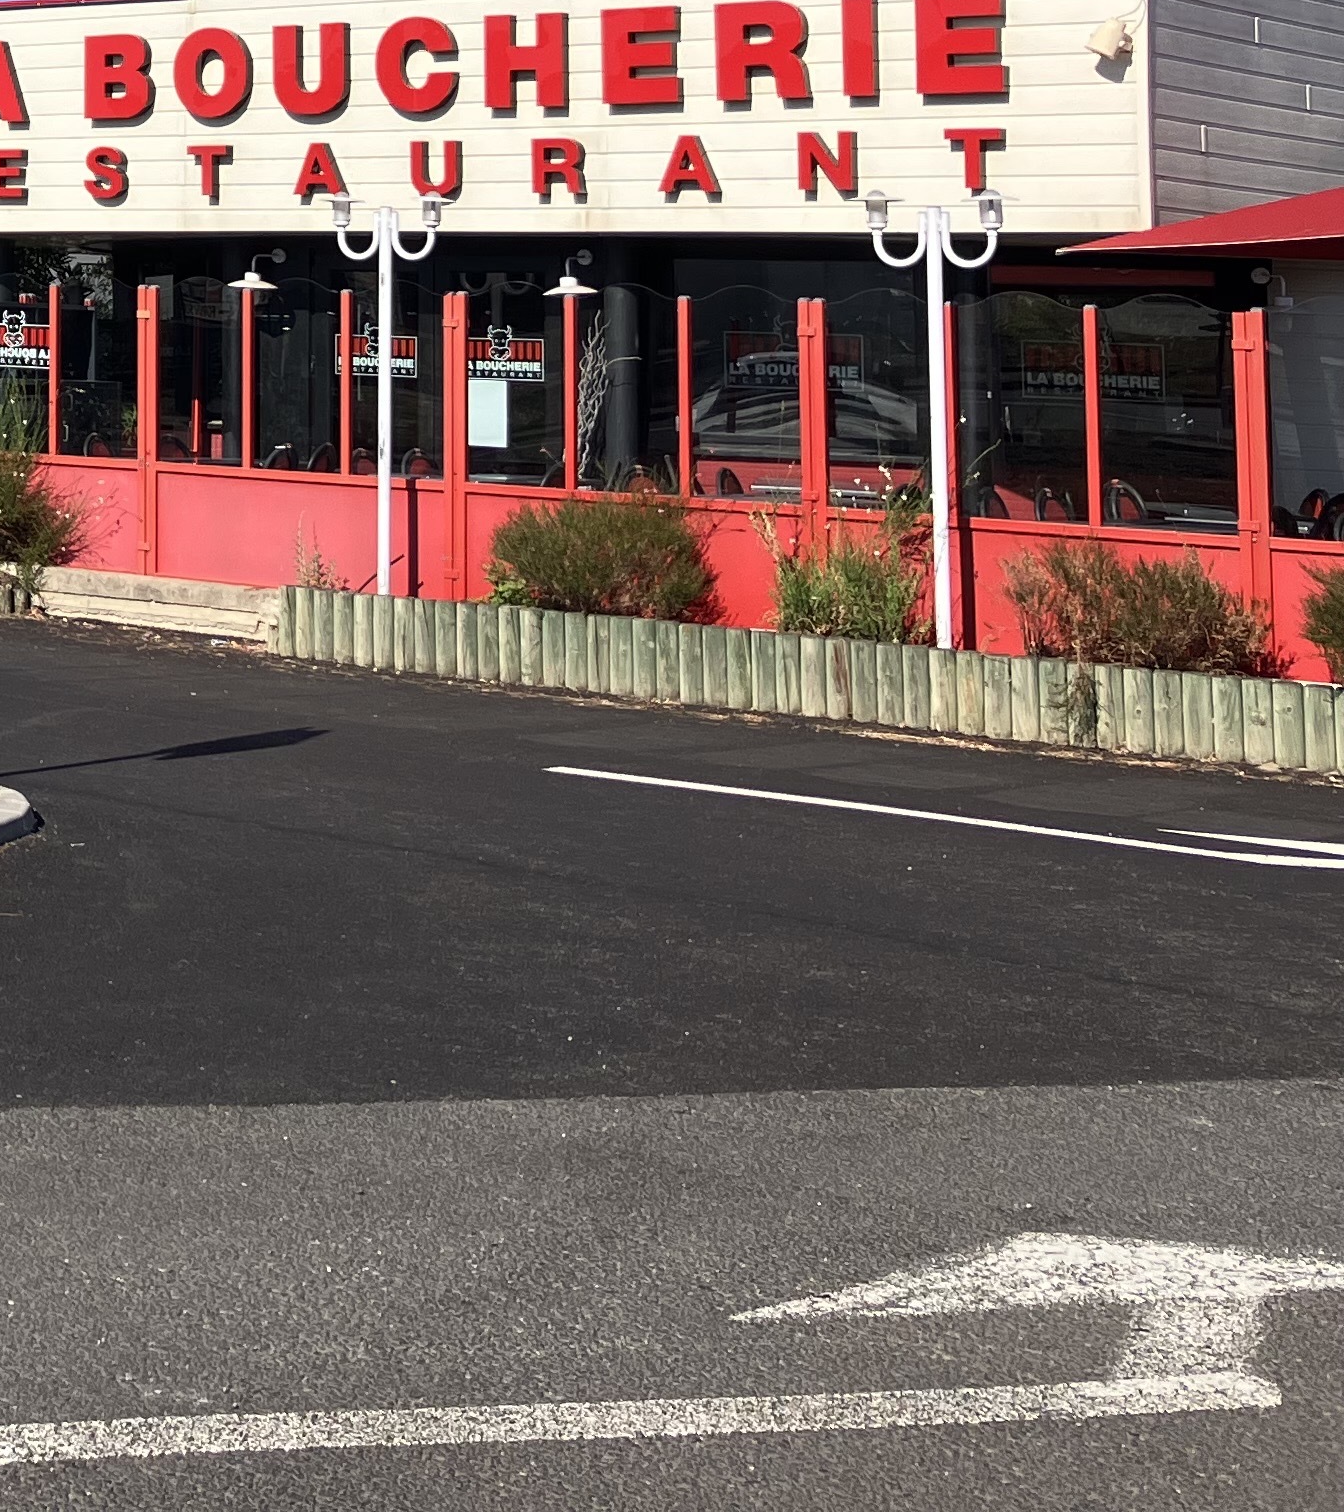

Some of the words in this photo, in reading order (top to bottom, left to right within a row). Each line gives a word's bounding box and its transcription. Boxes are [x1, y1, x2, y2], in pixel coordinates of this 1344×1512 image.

[476, 360, 541, 372] BOUCHERIE
[728, 362, 750, 375] LA
[1027, 371, 1049, 385] LA
